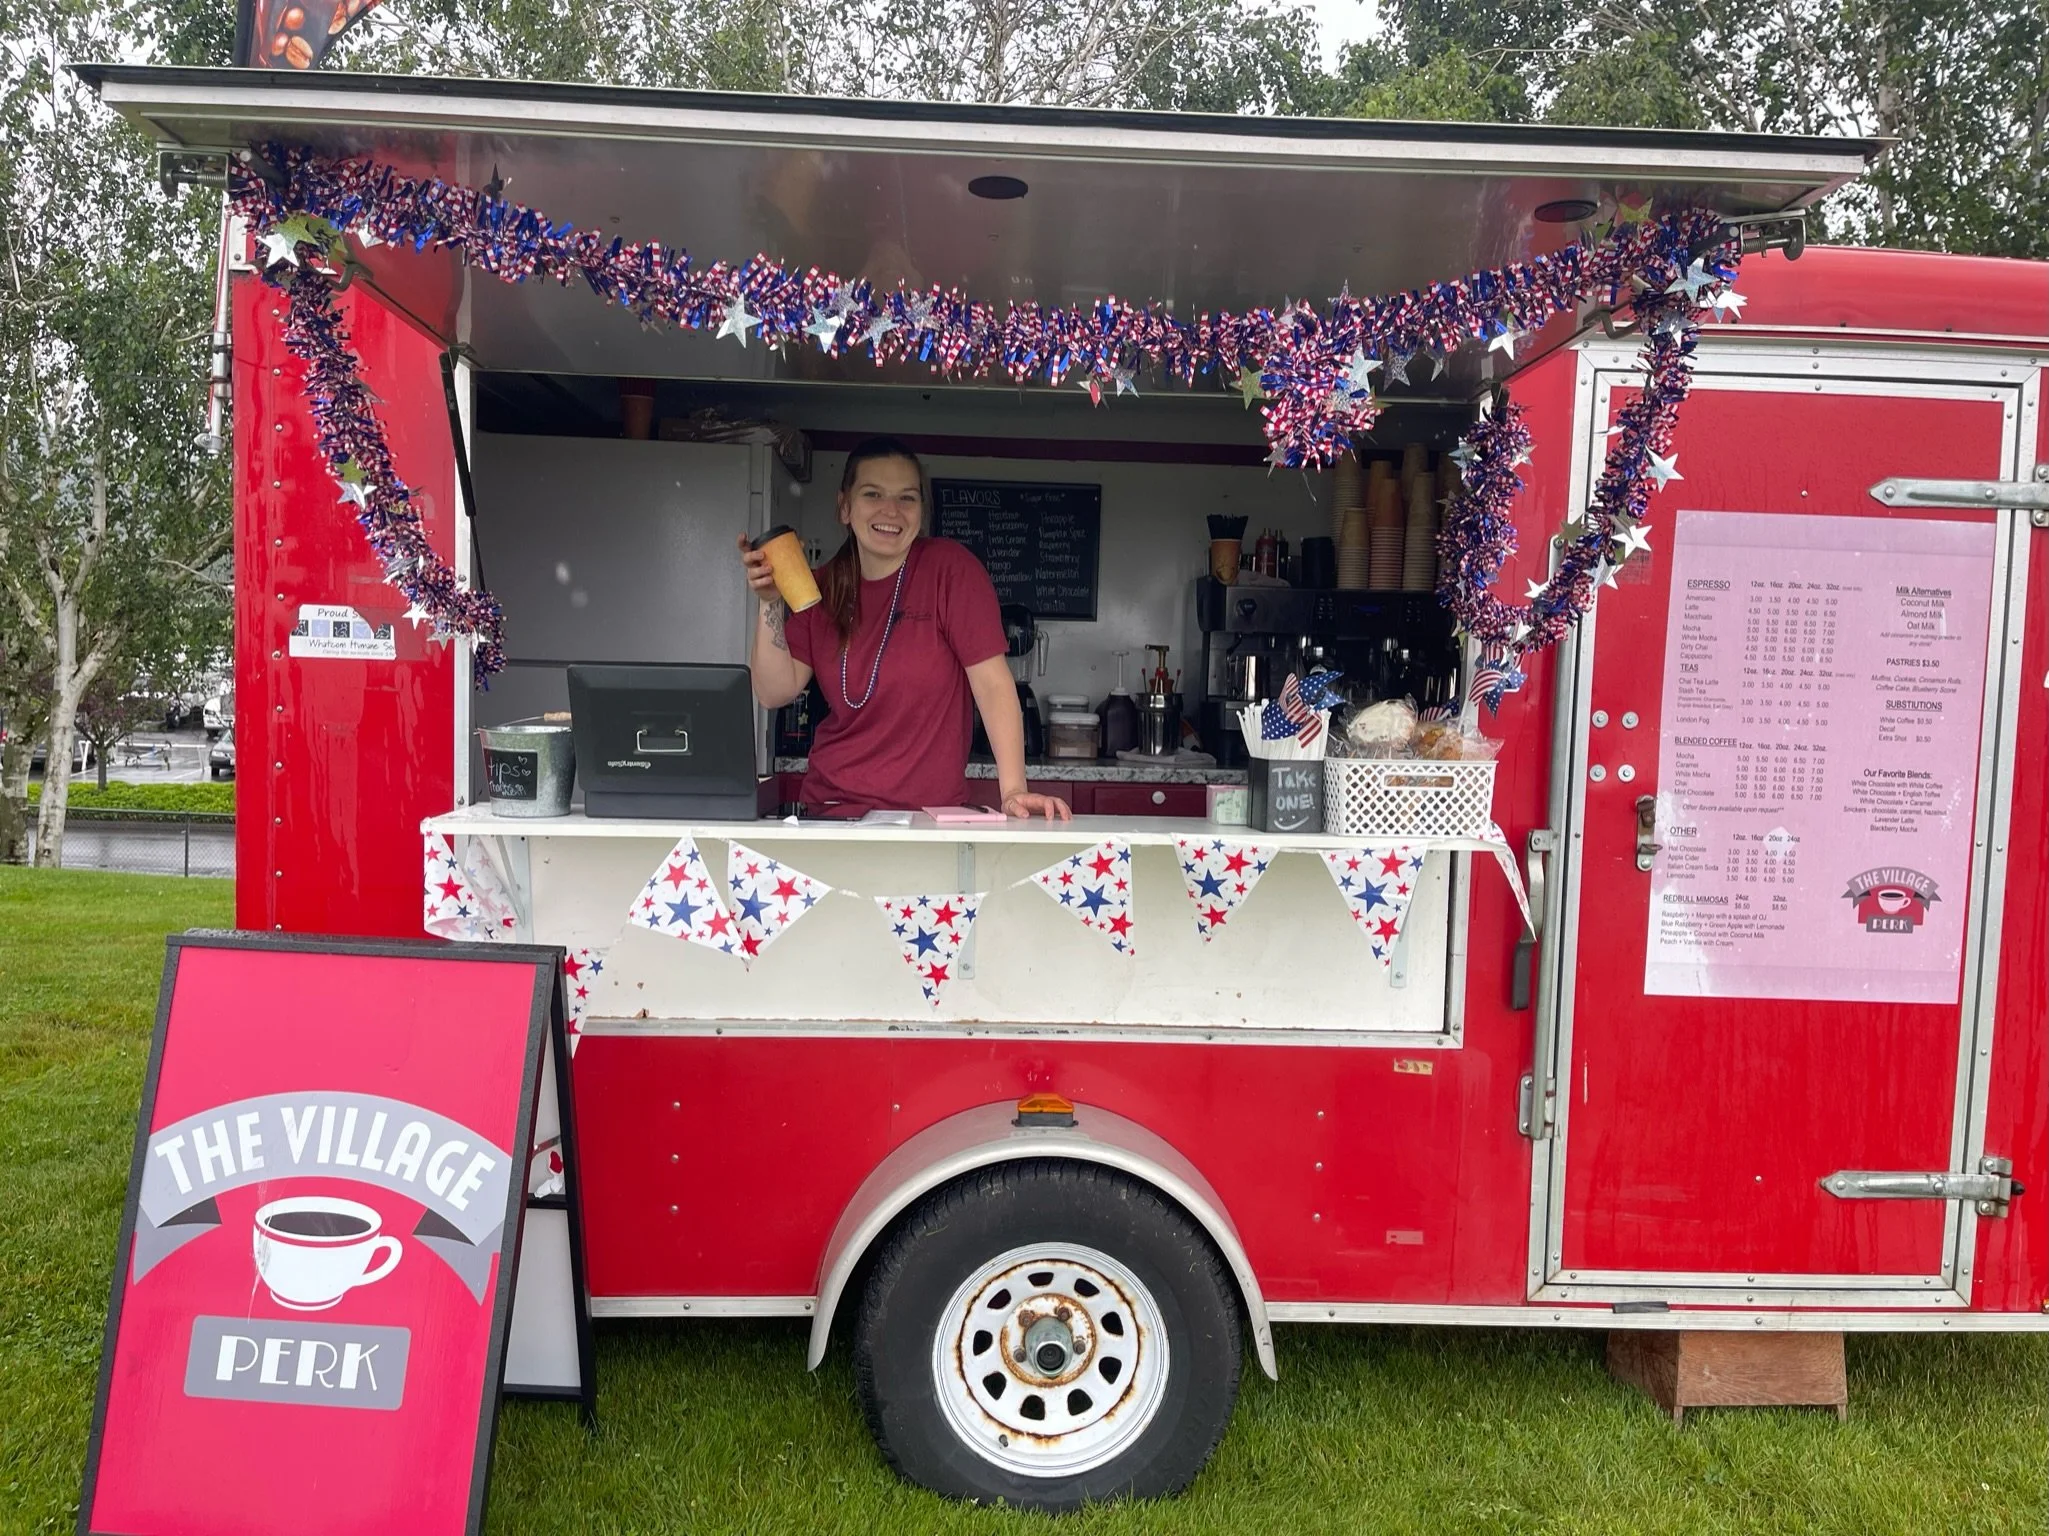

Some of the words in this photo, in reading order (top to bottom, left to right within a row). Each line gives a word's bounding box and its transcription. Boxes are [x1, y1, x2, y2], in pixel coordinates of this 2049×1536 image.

[941, 489, 1001, 505] FLAVORS
[986, 547, 1022, 558] Lavender
[986, 561, 1011, 573] Mango
[1687, 579, 1731, 590] ESPRESSO
[1896, 586, 1910, 595] Milk
[1911, 587, 1952, 597] Alternatives
[1685, 594, 1716, 602] Americano
[1900, 598, 1930, 607] Coconut
[1931, 599, 1944, 608] Milk
[317, 607, 348, 618] Proud
[1900, 610, 1927, 619] Almond
[1929, 611, 1943, 619] Milk
[1682, 624, 1701, 632] Mocha
[1906, 621, 1920, 630] Oat
[1921, 622, 1935, 630] Milk
[1698, 634, 1718, 642] Mocha
[309, 639, 347, 649] Whatcom
[1680, 643, 1694, 652] Dirty
[1694, 643, 1708, 651] Chai
[1681, 663, 1699, 673] TEAS
[1886, 658, 1921, 667] PASTRIES
[1922, 659, 1940, 668] $3.50
[1693, 678, 1704, 686] Tea
[1918, 676, 1947, 684] Cinnamon
[1695, 687, 1707, 695] Tea
[1875, 684, 1895, 692] Coffee
[1885, 699, 1943, 711] SUBSTIUTIONS
[1698, 716, 1710, 725] Fog
[1879, 716, 1896, 724] White
[1896, 717, 1915, 725] Coffee
[1879, 725, 1896, 733] Decaf
[1674, 736, 1708, 746] BLENDED
[1708, 737, 1737, 747] COFFEE
[1878, 734, 1893, 742] Extra
[1894, 734, 1907, 742] Shot
[1675, 752, 1695, 760] Mocha
[1675, 761, 1699, 769] Caramel
[487, 756, 521, 785] tips
[1675, 770, 1691, 778] White
[1692, 771, 1711, 779] Mocha
[1863, 768, 1877, 778] Our
[1878, 769, 1906, 779] Favorite
[1907, 770, 1933, 780] Blends:
[1271, 767, 1317, 788] Take
[1674, 779, 1688, 787] Chai
[1851, 780, 1868, 788] White
[1868, 780, 1896, 788] Chocolate
[1674, 788, 1686, 797] Mint
[1687, 789, 1715, 797] Chocolate
[1852, 788, 1869, 796] White
[1869, 789, 1897, 797] Chocolate
[1902, 790, 1923, 799] English
[1275, 795, 1316, 811] ONE!
[1859, 797, 1876, 805] White
[1876, 798, 1904, 806] Chocolate
[1909, 799, 1933, 807] Caramel
[1682, 803, 1698, 811] Other
[1698, 804, 1718, 812] flavors
[1718, 805, 1742, 813] available
[1843, 806, 1867, 814] Snickers
[1874, 816, 1900, 824] Lavender
[1900, 816, 1915, 824] Latte
[1669, 826, 1698, 837] OTHER
[1870, 824, 1898, 833] Blackberry
[1899, 825, 1918, 833] Mocha
[1667, 854, 1684, 862] Apple
[1666, 872, 1696, 880] Lemonade
[1855, 871, 1881, 890] THE
[1881, 869, 1930, 892] VILLAGE
[1663, 894, 1694, 904] REDBULL
[1696, 895, 1729, 905] MIMOSAS
[1661, 911, 1690, 919] Raspberry
[1696, 912, 1715, 920] Mango
[1733, 913, 1751, 922] splash
[1758, 913, 1767, 921] OJ
[1674, 920, 1703, 929] Raspberry
[1709, 921, 1726, 929] Green
[1727, 922, 1743, 930] Apple
[1756, 923, 1785, 931] Lemonade
[1872, 918, 1909, 931] PERK
[1660, 929, 1688, 938] Pineapple
[1693, 930, 1717, 938] Coconut
[1729, 931, 1753, 939] Coconut
[1753, 931, 1765, 939] Milk
[1684, 938, 1702, 946] Vanilla
[1715, 939, 1734, 947] Cream
[155, 1111, 264, 1196] THE
[279, 1104, 497, 1213] VILLAGE
[215, 1334, 380, 1392] PERK
